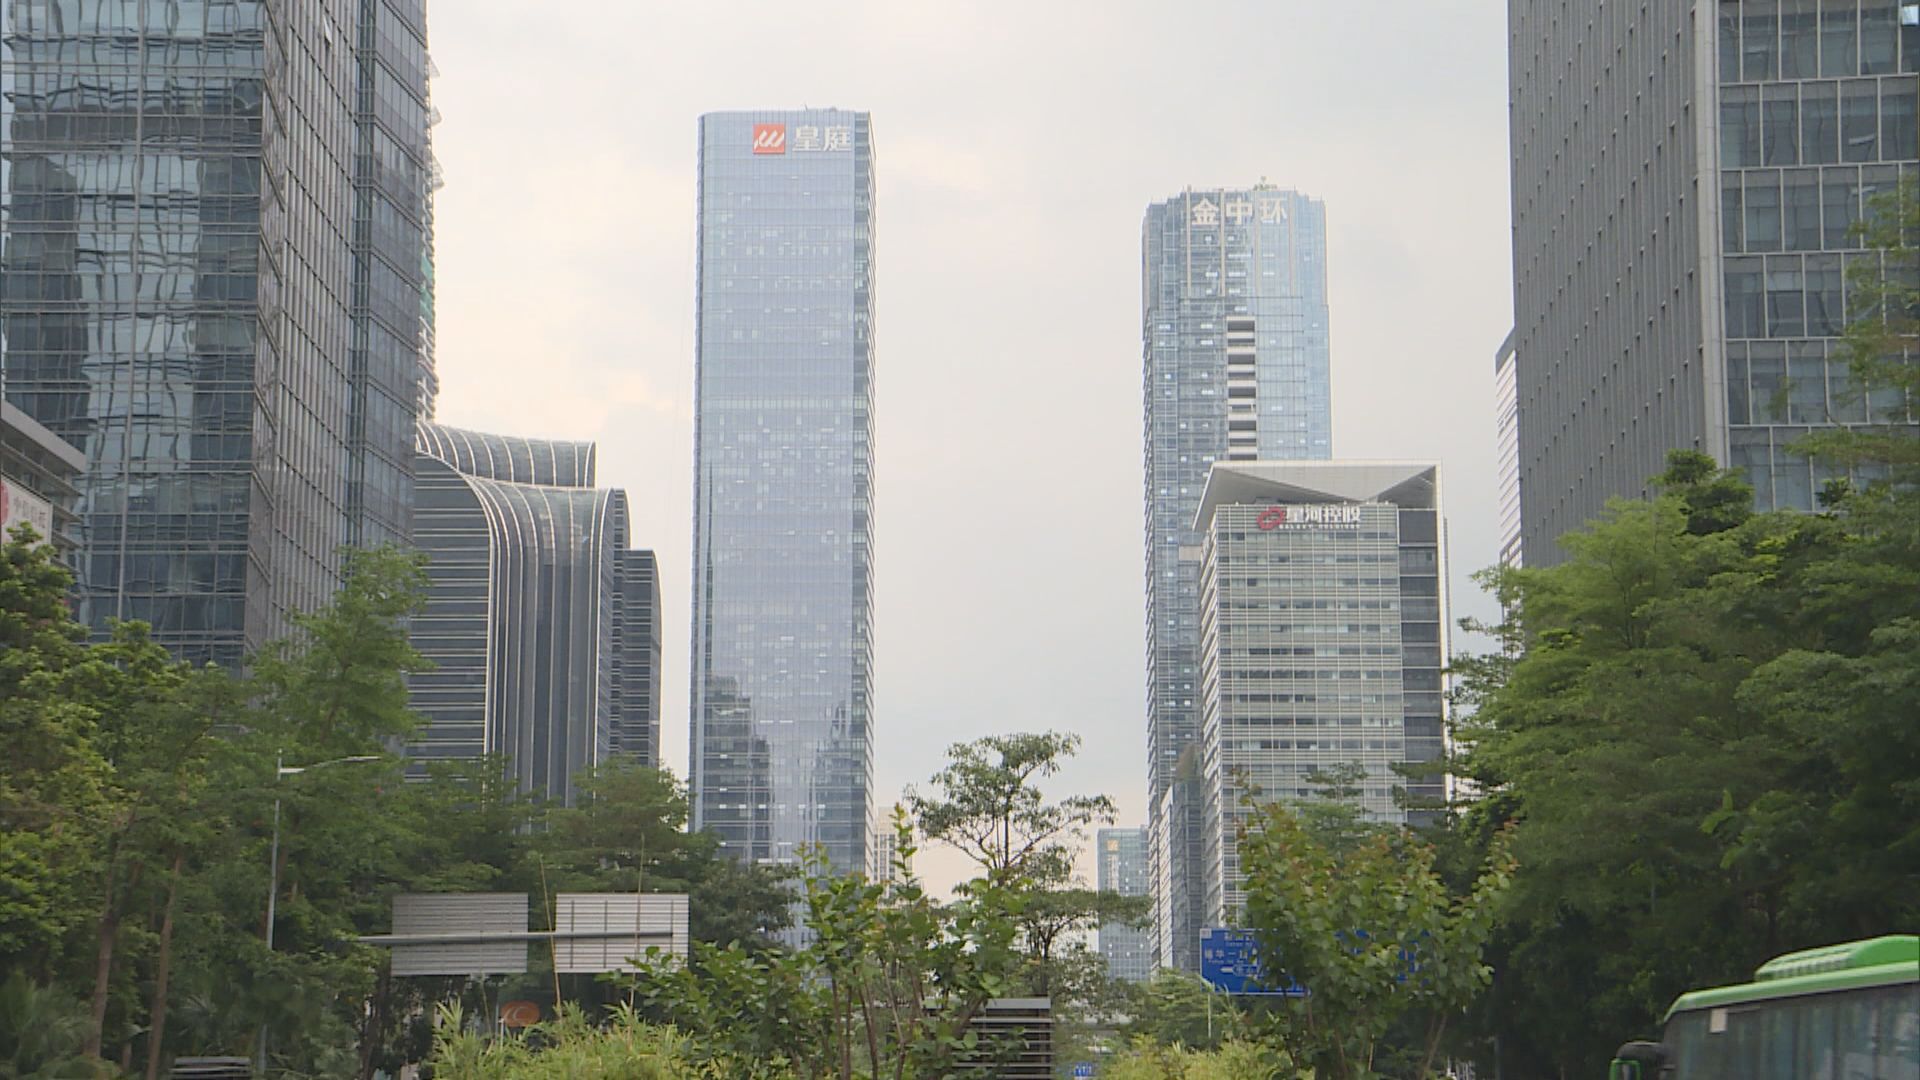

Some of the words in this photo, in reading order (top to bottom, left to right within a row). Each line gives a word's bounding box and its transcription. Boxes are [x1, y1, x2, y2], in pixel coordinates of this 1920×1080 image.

[792, 125, 852, 152] 皇庭
[1191, 196, 1288, 225] 金中环
[1286, 504, 1361, 523] 星河控股
